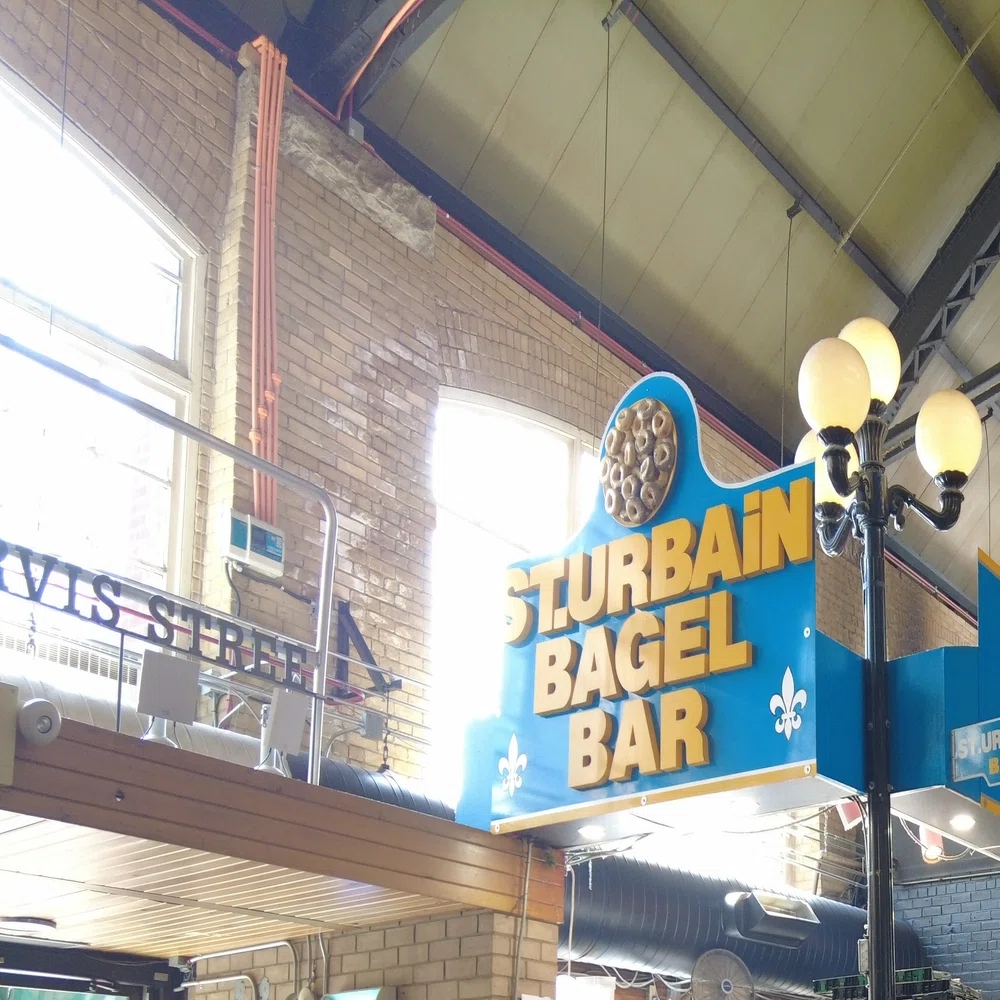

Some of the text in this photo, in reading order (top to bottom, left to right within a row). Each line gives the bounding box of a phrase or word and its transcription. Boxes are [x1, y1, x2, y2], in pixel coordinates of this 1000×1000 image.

[0, 540, 122, 628] VIS
[533, 590, 754, 717] BAGEL
[568, 687, 711, 790] BAR
